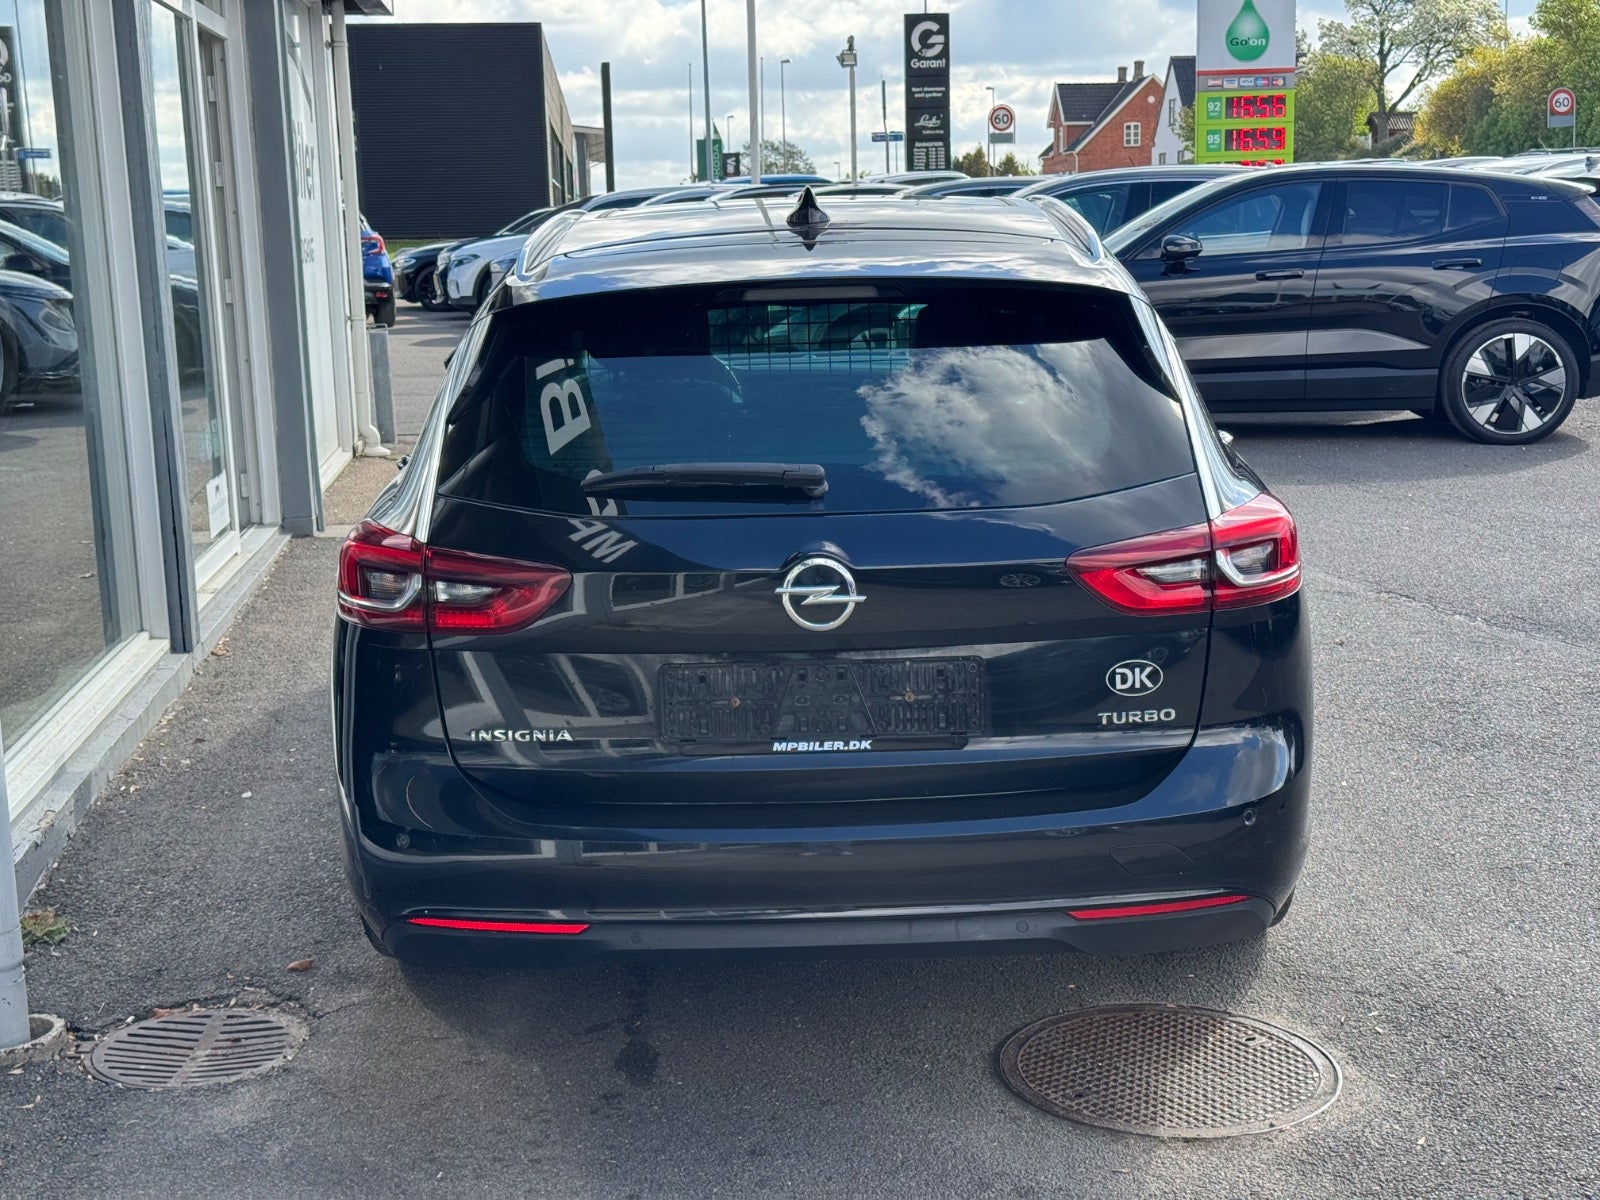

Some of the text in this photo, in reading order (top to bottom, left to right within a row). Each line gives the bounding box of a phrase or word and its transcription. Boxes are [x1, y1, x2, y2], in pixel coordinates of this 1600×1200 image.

[1230, 37, 1266, 47] Go'on
[910, 58, 946, 69] Garant
[1207, 102, 1221, 111] 92
[1554, 97, 1570, 108] 60
[994, 113, 1009, 125] 60
[1207, 134, 1221, 144] 95
[1115, 666, 1155, 690] DK
[1097, 708, 1176, 725] TURBO
[470, 729, 574, 743] INSIGNIA
[772, 739, 873, 752] MPBILER.DK
